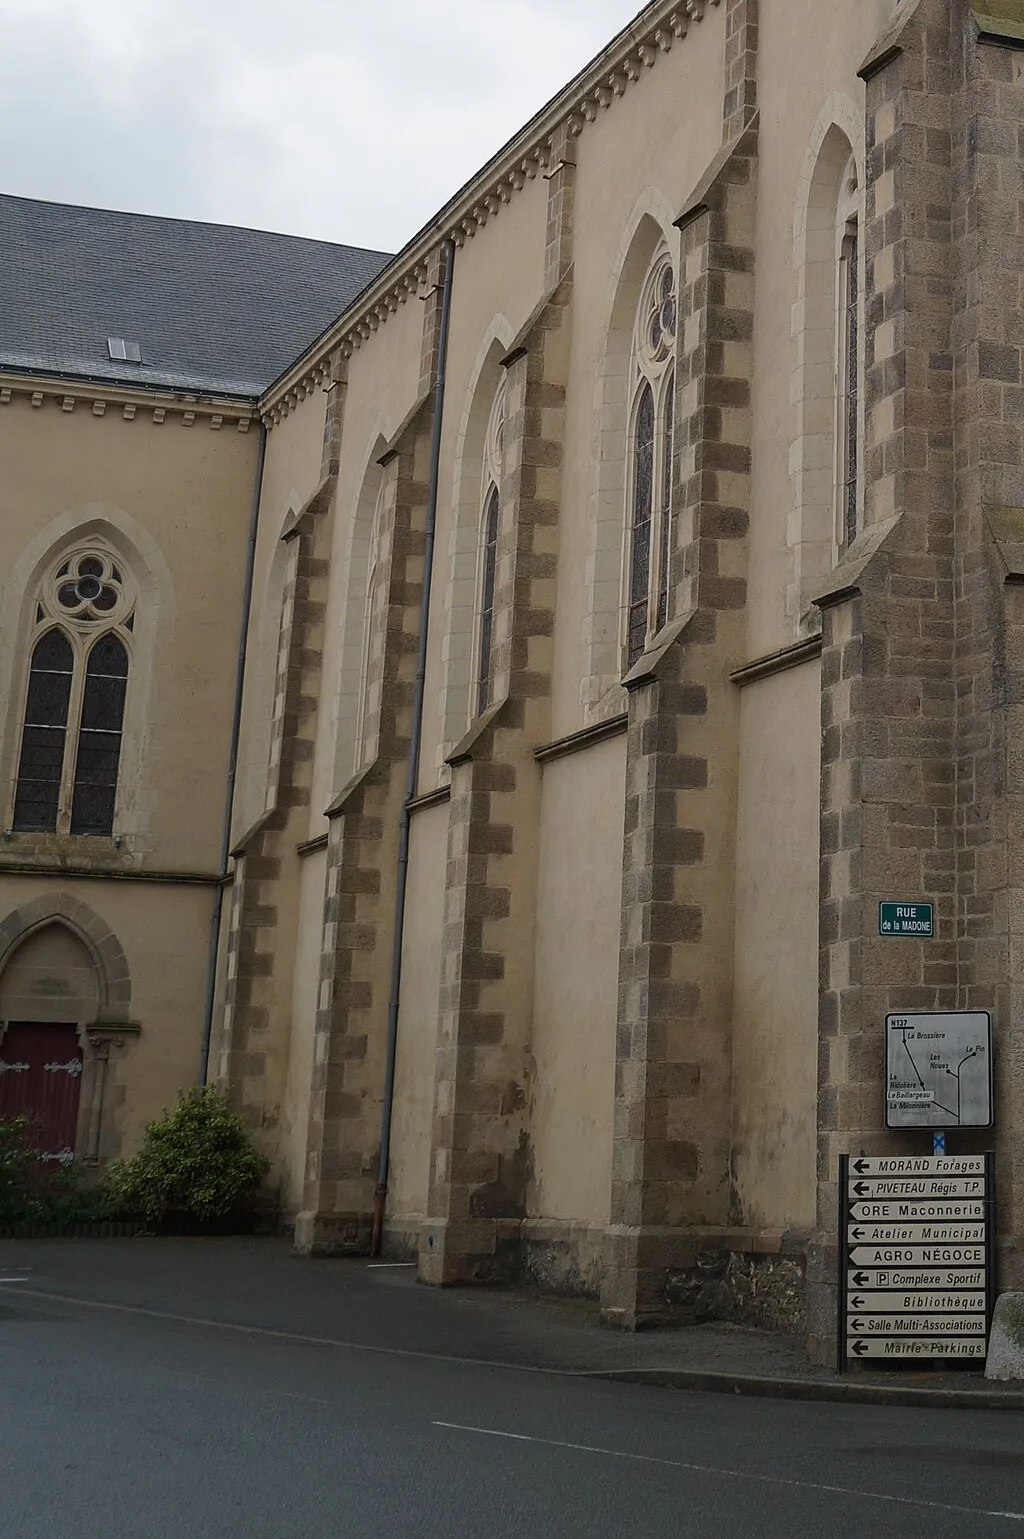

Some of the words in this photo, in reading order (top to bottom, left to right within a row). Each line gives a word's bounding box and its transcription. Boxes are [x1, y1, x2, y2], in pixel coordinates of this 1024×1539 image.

[897, 908, 916, 917] RUE
[883, 921, 891, 929] de
[894, 921, 899, 930] la
[902, 921, 930, 931] MADONE
[878, 1160, 930, 1171] MORAND
[936, 1160, 981, 1172] Forages
[876, 1183, 925, 1193] PIVETEAU
[931, 1183, 957, 1194] Régis
[964, 1182, 981, 1192] T.P.
[862, 1206, 890, 1216] ORE
[899, 1205, 981, 1215] Maconnerie
[872, 1228, 913, 1238] Atelier
[922, 1227, 984, 1240] Municipal
[874, 1250, 913, 1261] AGRO
[923, 1248, 981, 1260] NÉGOCE
[892, 1274, 940, 1286] Complexe
[947, 1273, 981, 1284] Sportif
[904, 1297, 983, 1309] Bibliothèque
[868, 1320, 891, 1330] Salle
[894, 1320, 983, 1330] Multi-Associations
[884, 1342, 920, 1353] Mairie
[931, 1342, 981, 1354] Parkings
